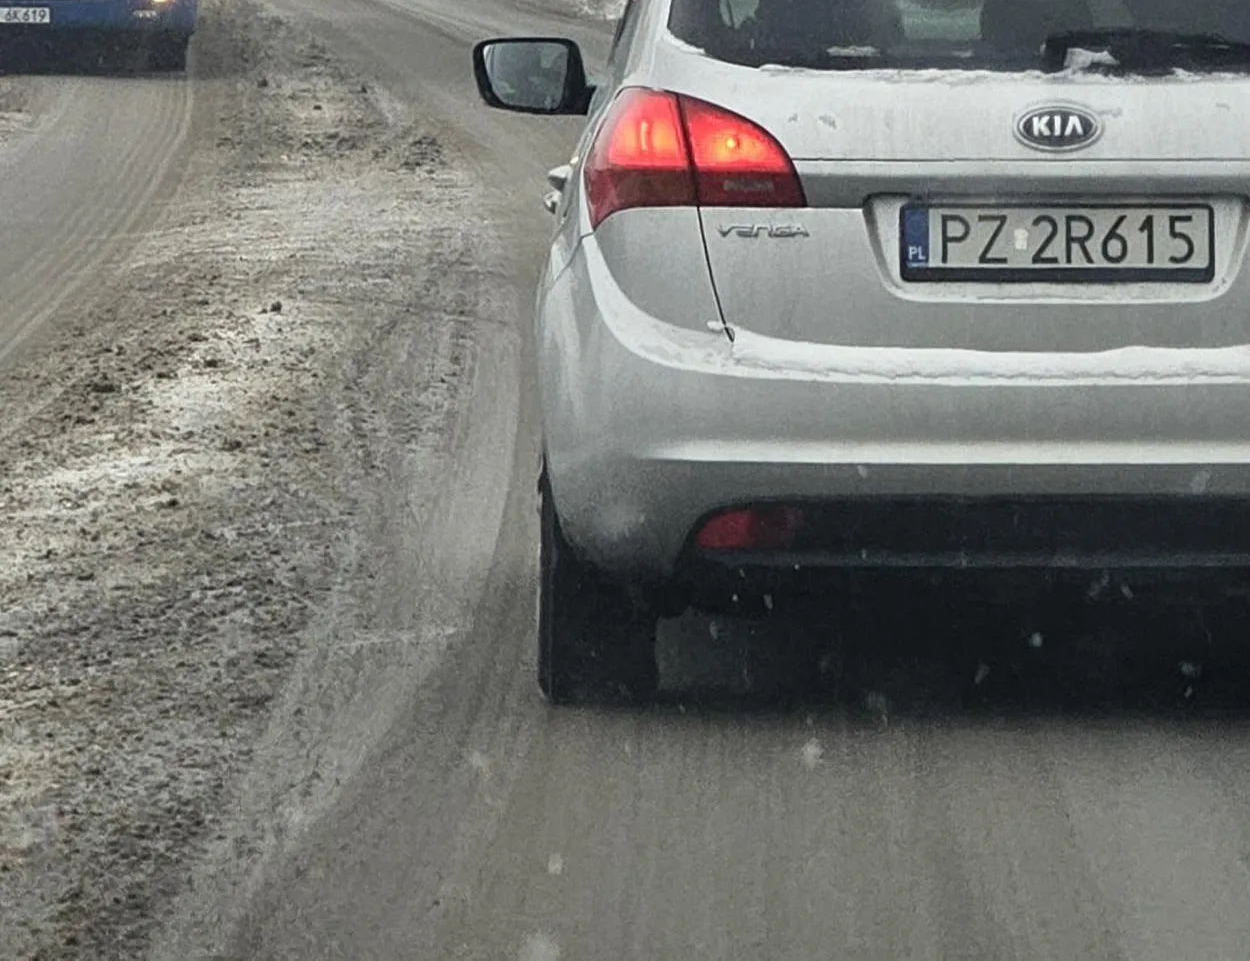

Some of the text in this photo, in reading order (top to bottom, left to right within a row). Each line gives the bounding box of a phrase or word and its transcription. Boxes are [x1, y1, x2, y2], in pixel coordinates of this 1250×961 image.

[1032, 116, 1084, 137] KIA
[718, 224, 810, 239] VENGA
[940, 214, 1194, 264] PZ 2R615
[908, 246, 926, 261] PL
